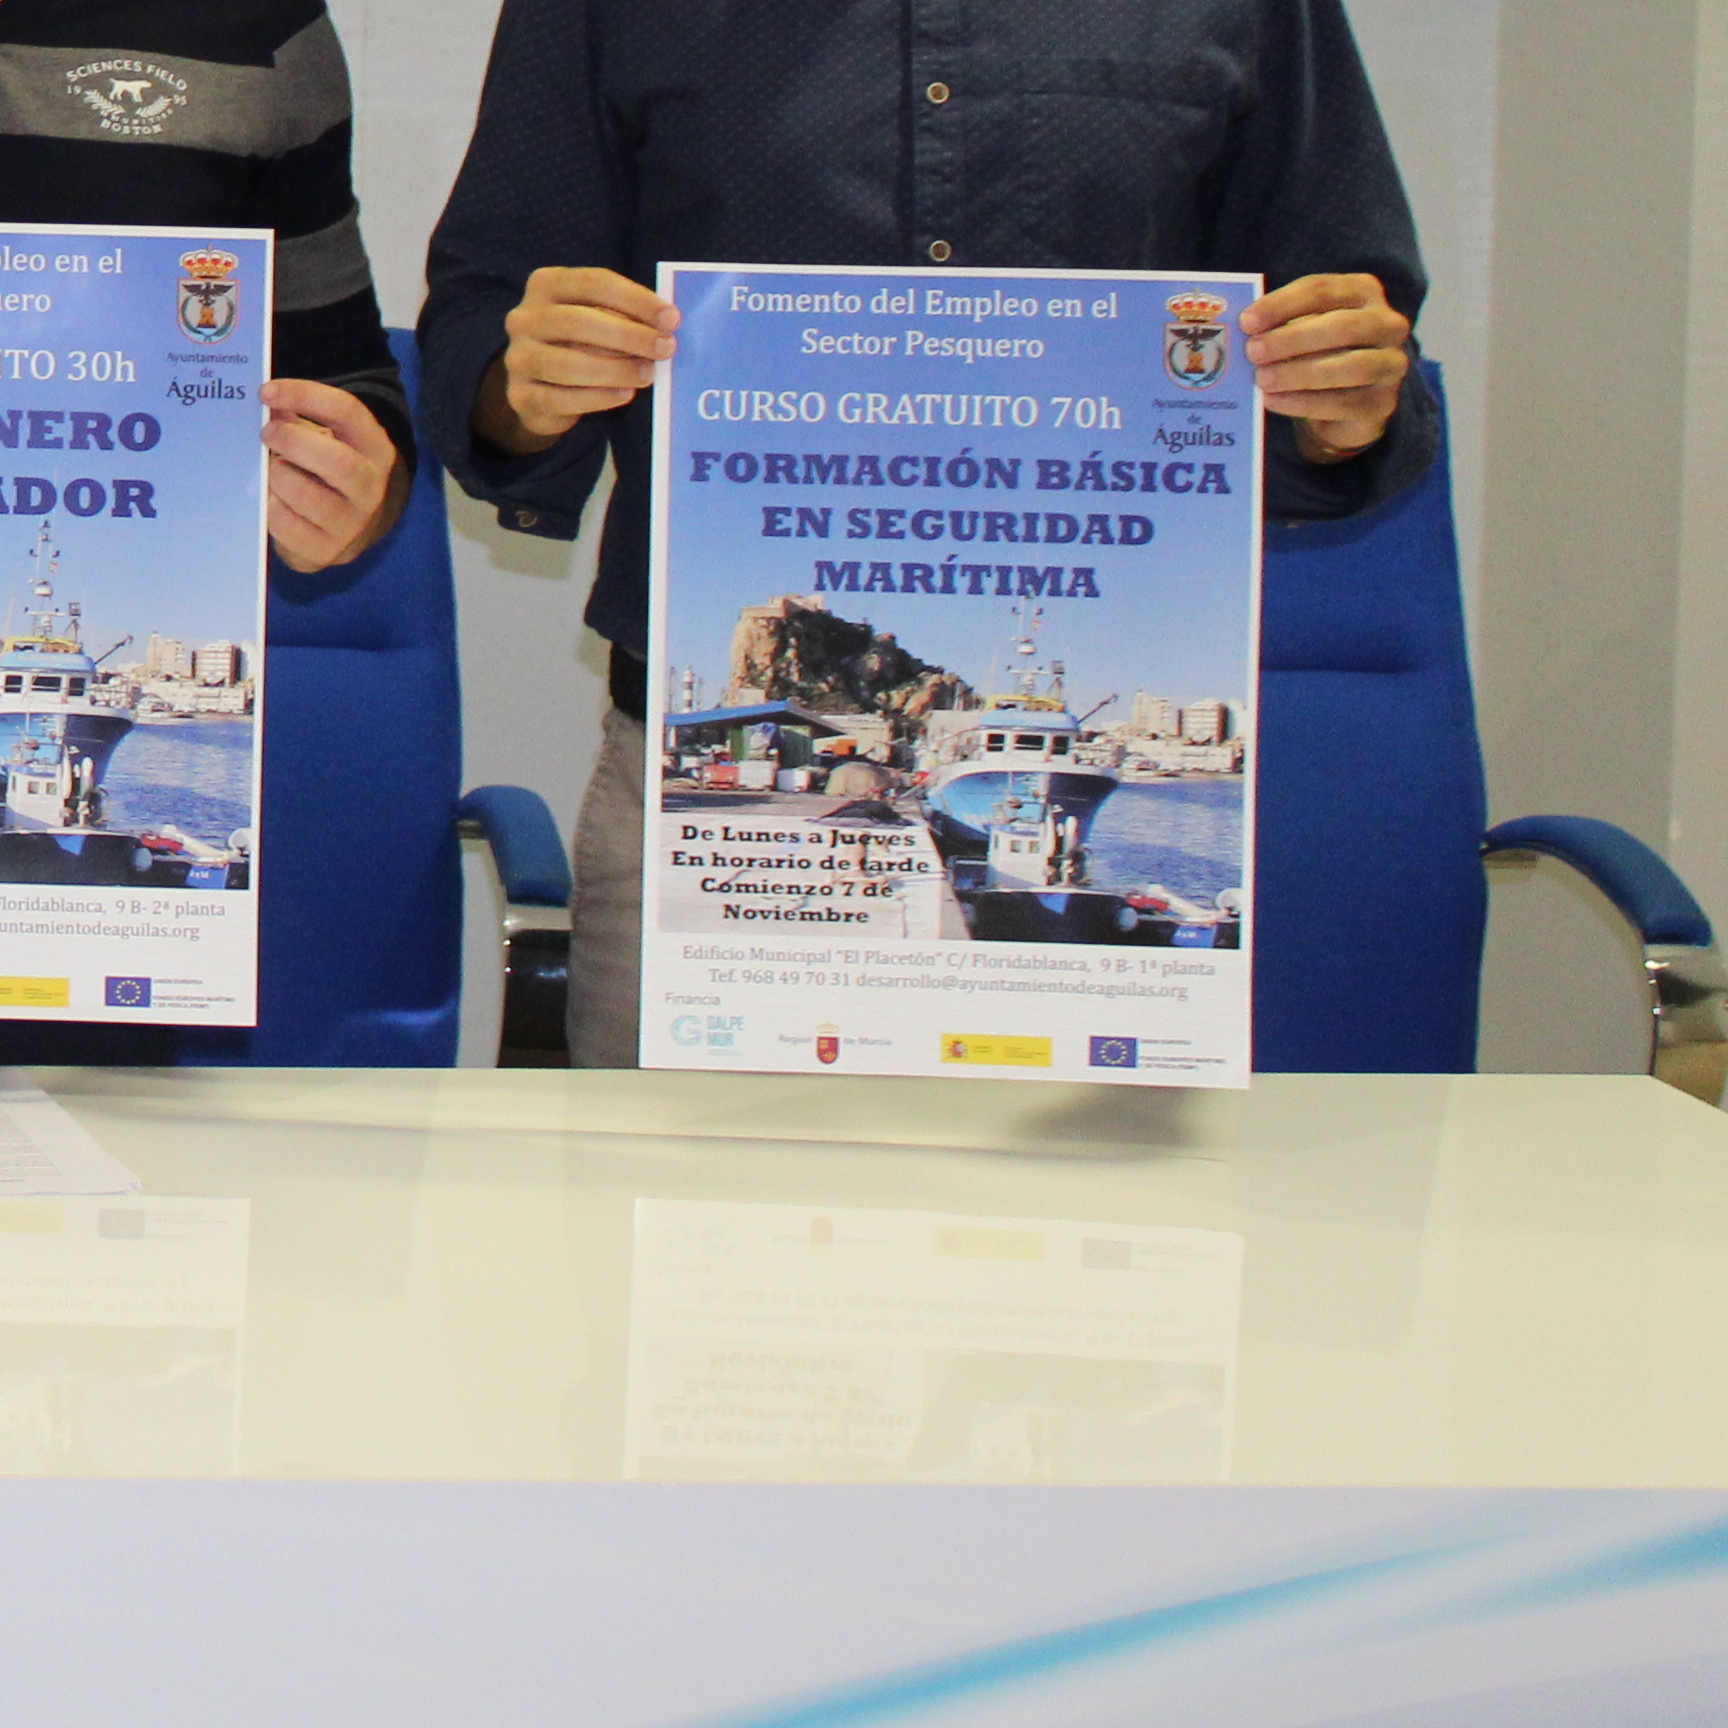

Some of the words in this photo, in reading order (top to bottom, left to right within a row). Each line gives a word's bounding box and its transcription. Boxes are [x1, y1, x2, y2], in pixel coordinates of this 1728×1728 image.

[65, 58, 143, 83] SCIENCES
[146, 62, 189, 92] FIELD
[100, 118, 164, 137] BOSTON
[55, 254, 89, 273] en
[98, 248, 123, 274] el
[729, 284, 862, 315] Fomento
[870, 288, 915, 315] del
[925, 289, 1039, 324] Empleo
[1046, 298, 1083, 318] en
[1091, 292, 1118, 319] el
[167, 352, 249, 366] Ayuntamiento
[801, 327, 898, 356] Sector
[905, 330, 1045, 364] Pesquero
[68, 351, 136, 382] 30h
[166, 376, 246, 405] Águilas
[698, 389, 827, 423] CURSO
[838, 392, 1039, 427] GRATUITO
[1051, 396, 1122, 430] 70h
[690, 447, 1022, 489] FORMACIÓN
[1036, 448, 1231, 494] BÁSICA
[762, 507, 833, 538] EN
[847, 508, 1154, 546] SEGURIDAD
[814, 553, 1100, 599] MARÍTIMA
[681, 825, 714, 841] De
[722, 826, 800, 843] Lunes
[808, 833, 823, 844] a
[829, 825, 915, 850] Jueves
[672, 851, 704, 867] En
[711, 852, 811, 873] horario
[819, 855, 851, 870] de
[859, 854, 929, 873] tarde
[701, 876, 834, 898] Comienzo
[842, 881, 855, 897] 7
[863, 880, 894, 898] de
[723, 904, 868, 924] Noviembre
